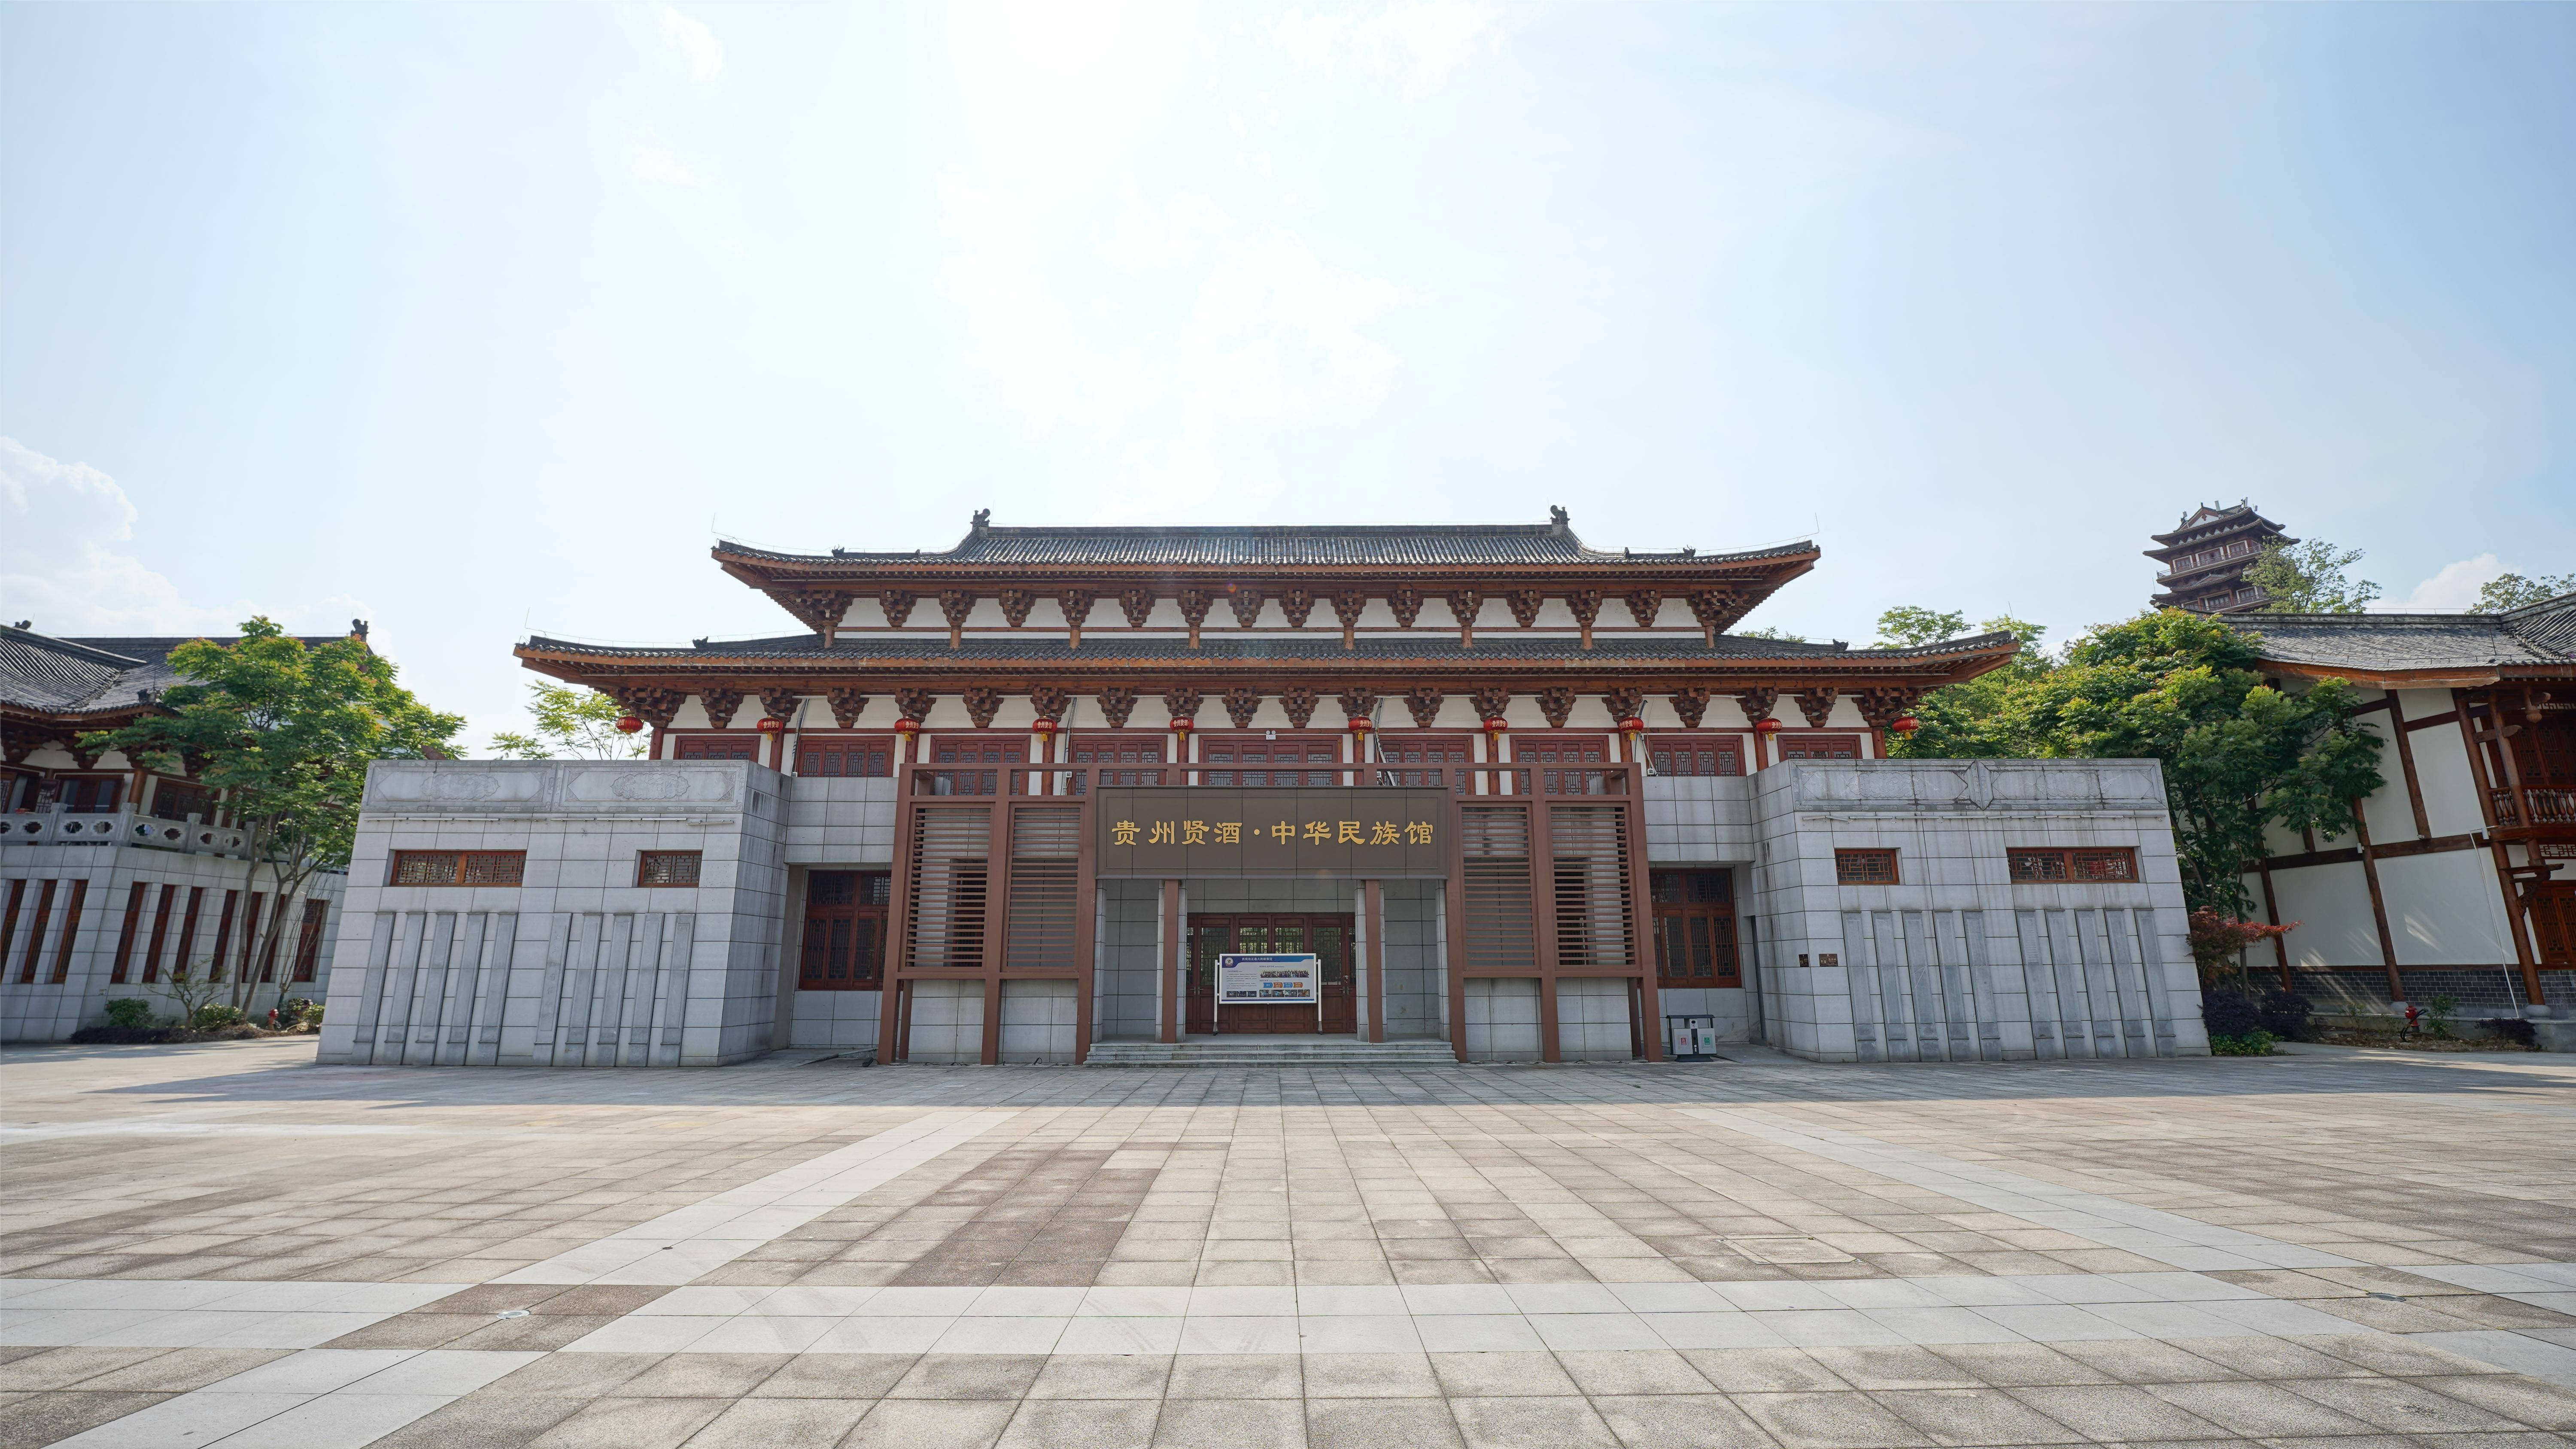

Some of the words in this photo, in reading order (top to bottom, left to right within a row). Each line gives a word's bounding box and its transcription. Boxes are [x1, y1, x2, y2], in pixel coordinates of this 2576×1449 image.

[763, 721, 779, 729] 贵州贤酒
[1173, 719, 1188, 727] 贵州贤酒
